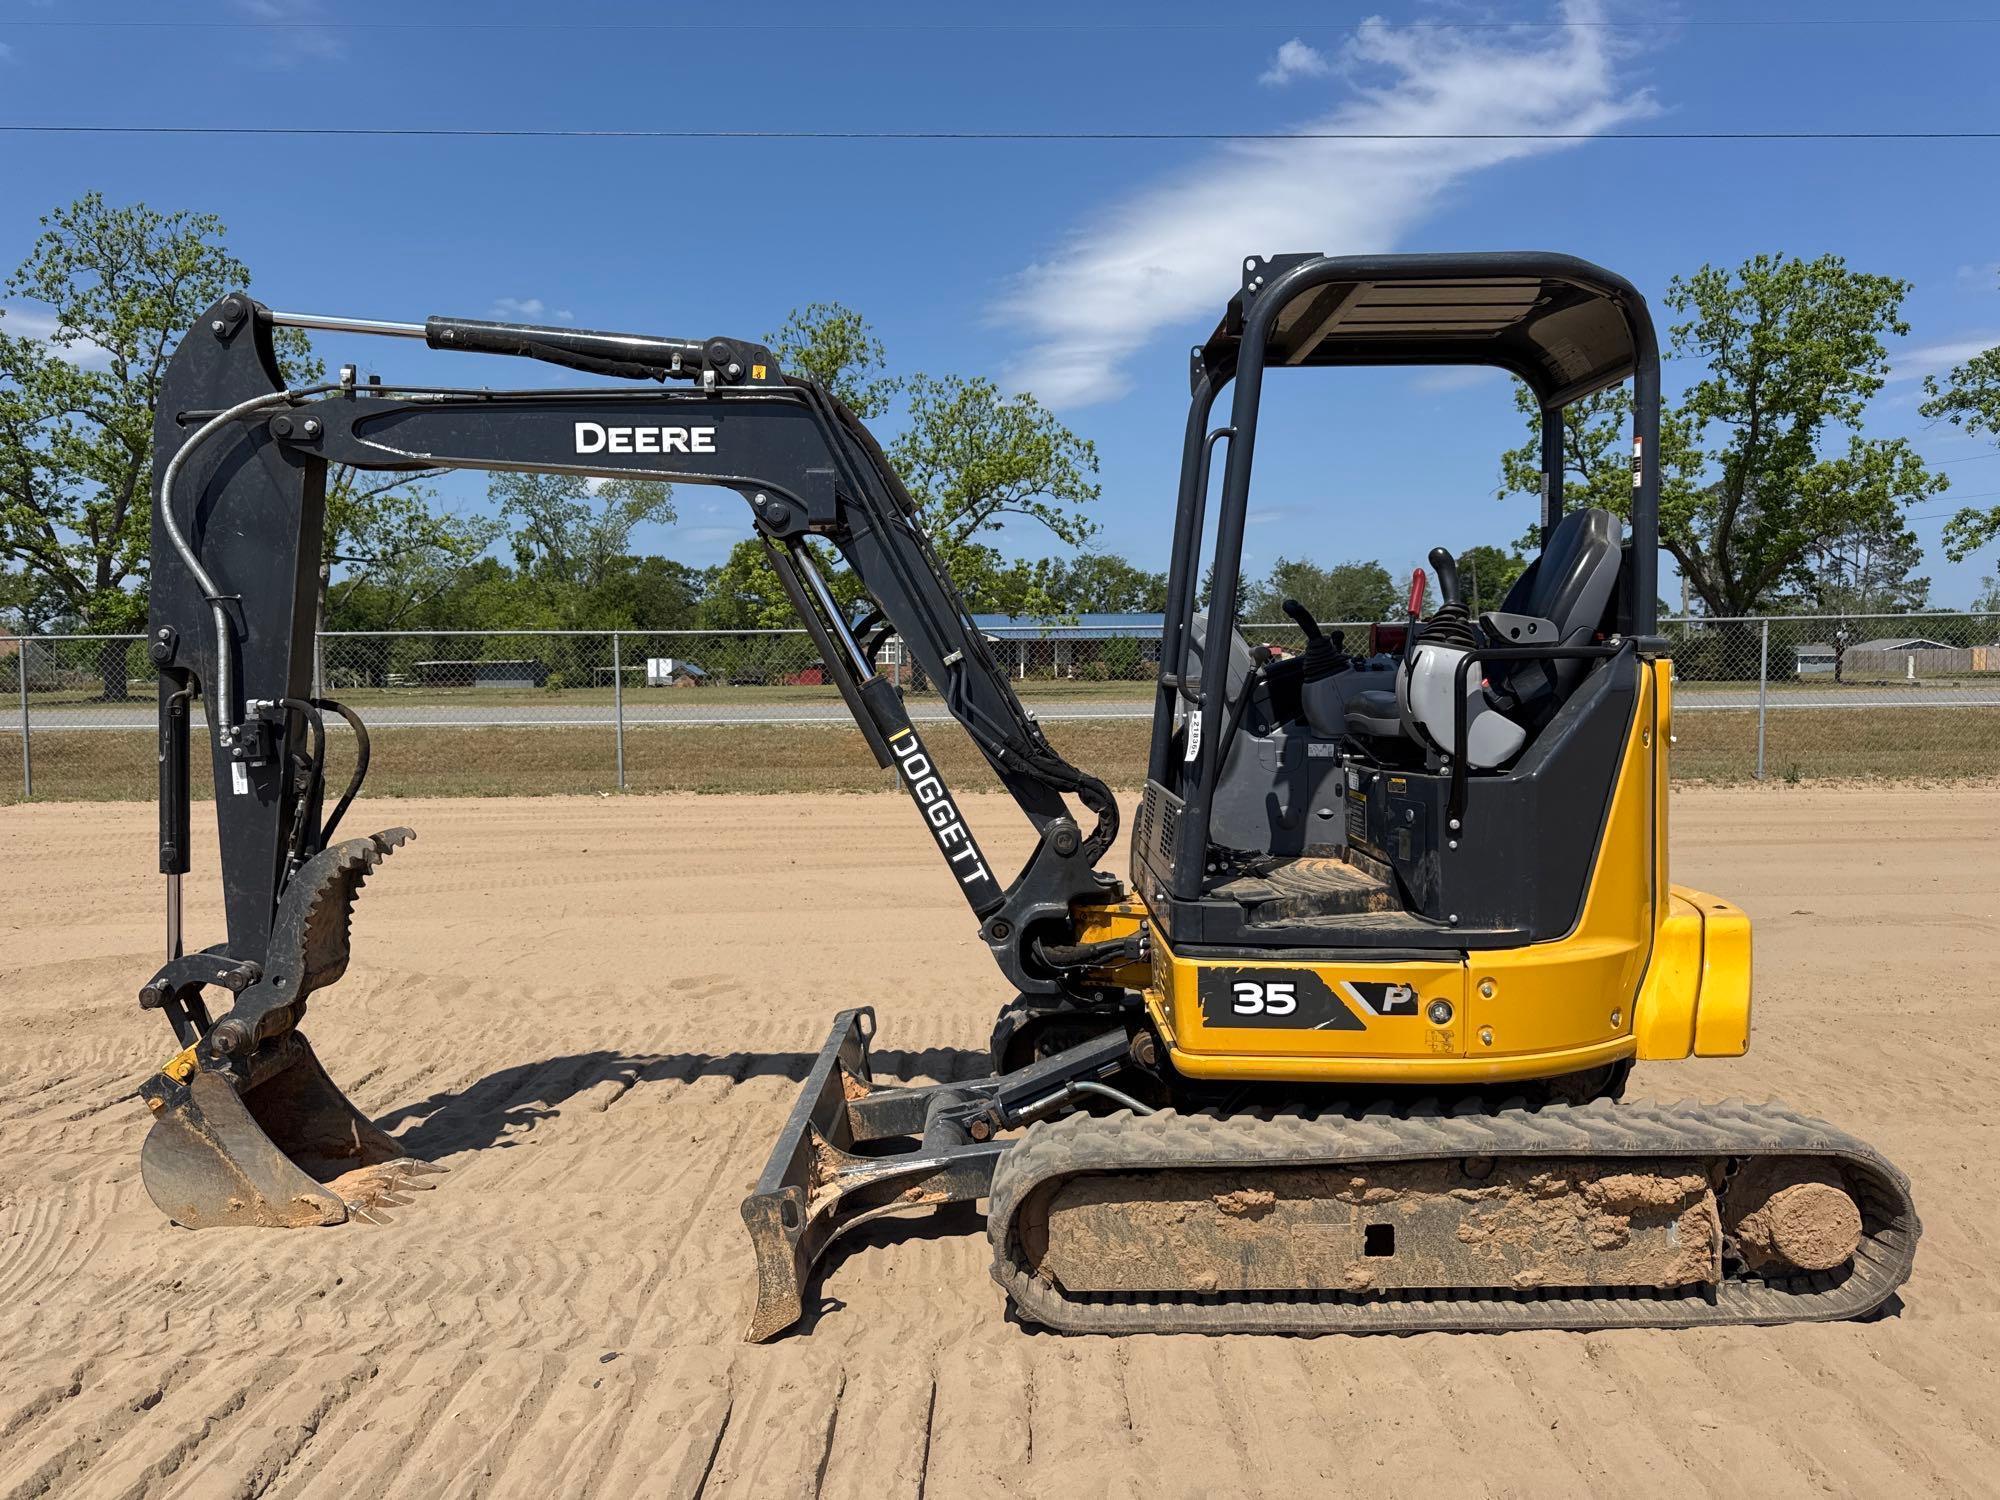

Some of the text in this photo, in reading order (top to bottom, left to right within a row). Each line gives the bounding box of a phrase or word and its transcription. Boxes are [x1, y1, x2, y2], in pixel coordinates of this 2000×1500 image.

[575, 422, 716, 453] DEERE
[889, 728, 990, 883] DOGGETT
[1233, 983, 1297, 1015] 35
[1382, 986, 1412, 1012] P
